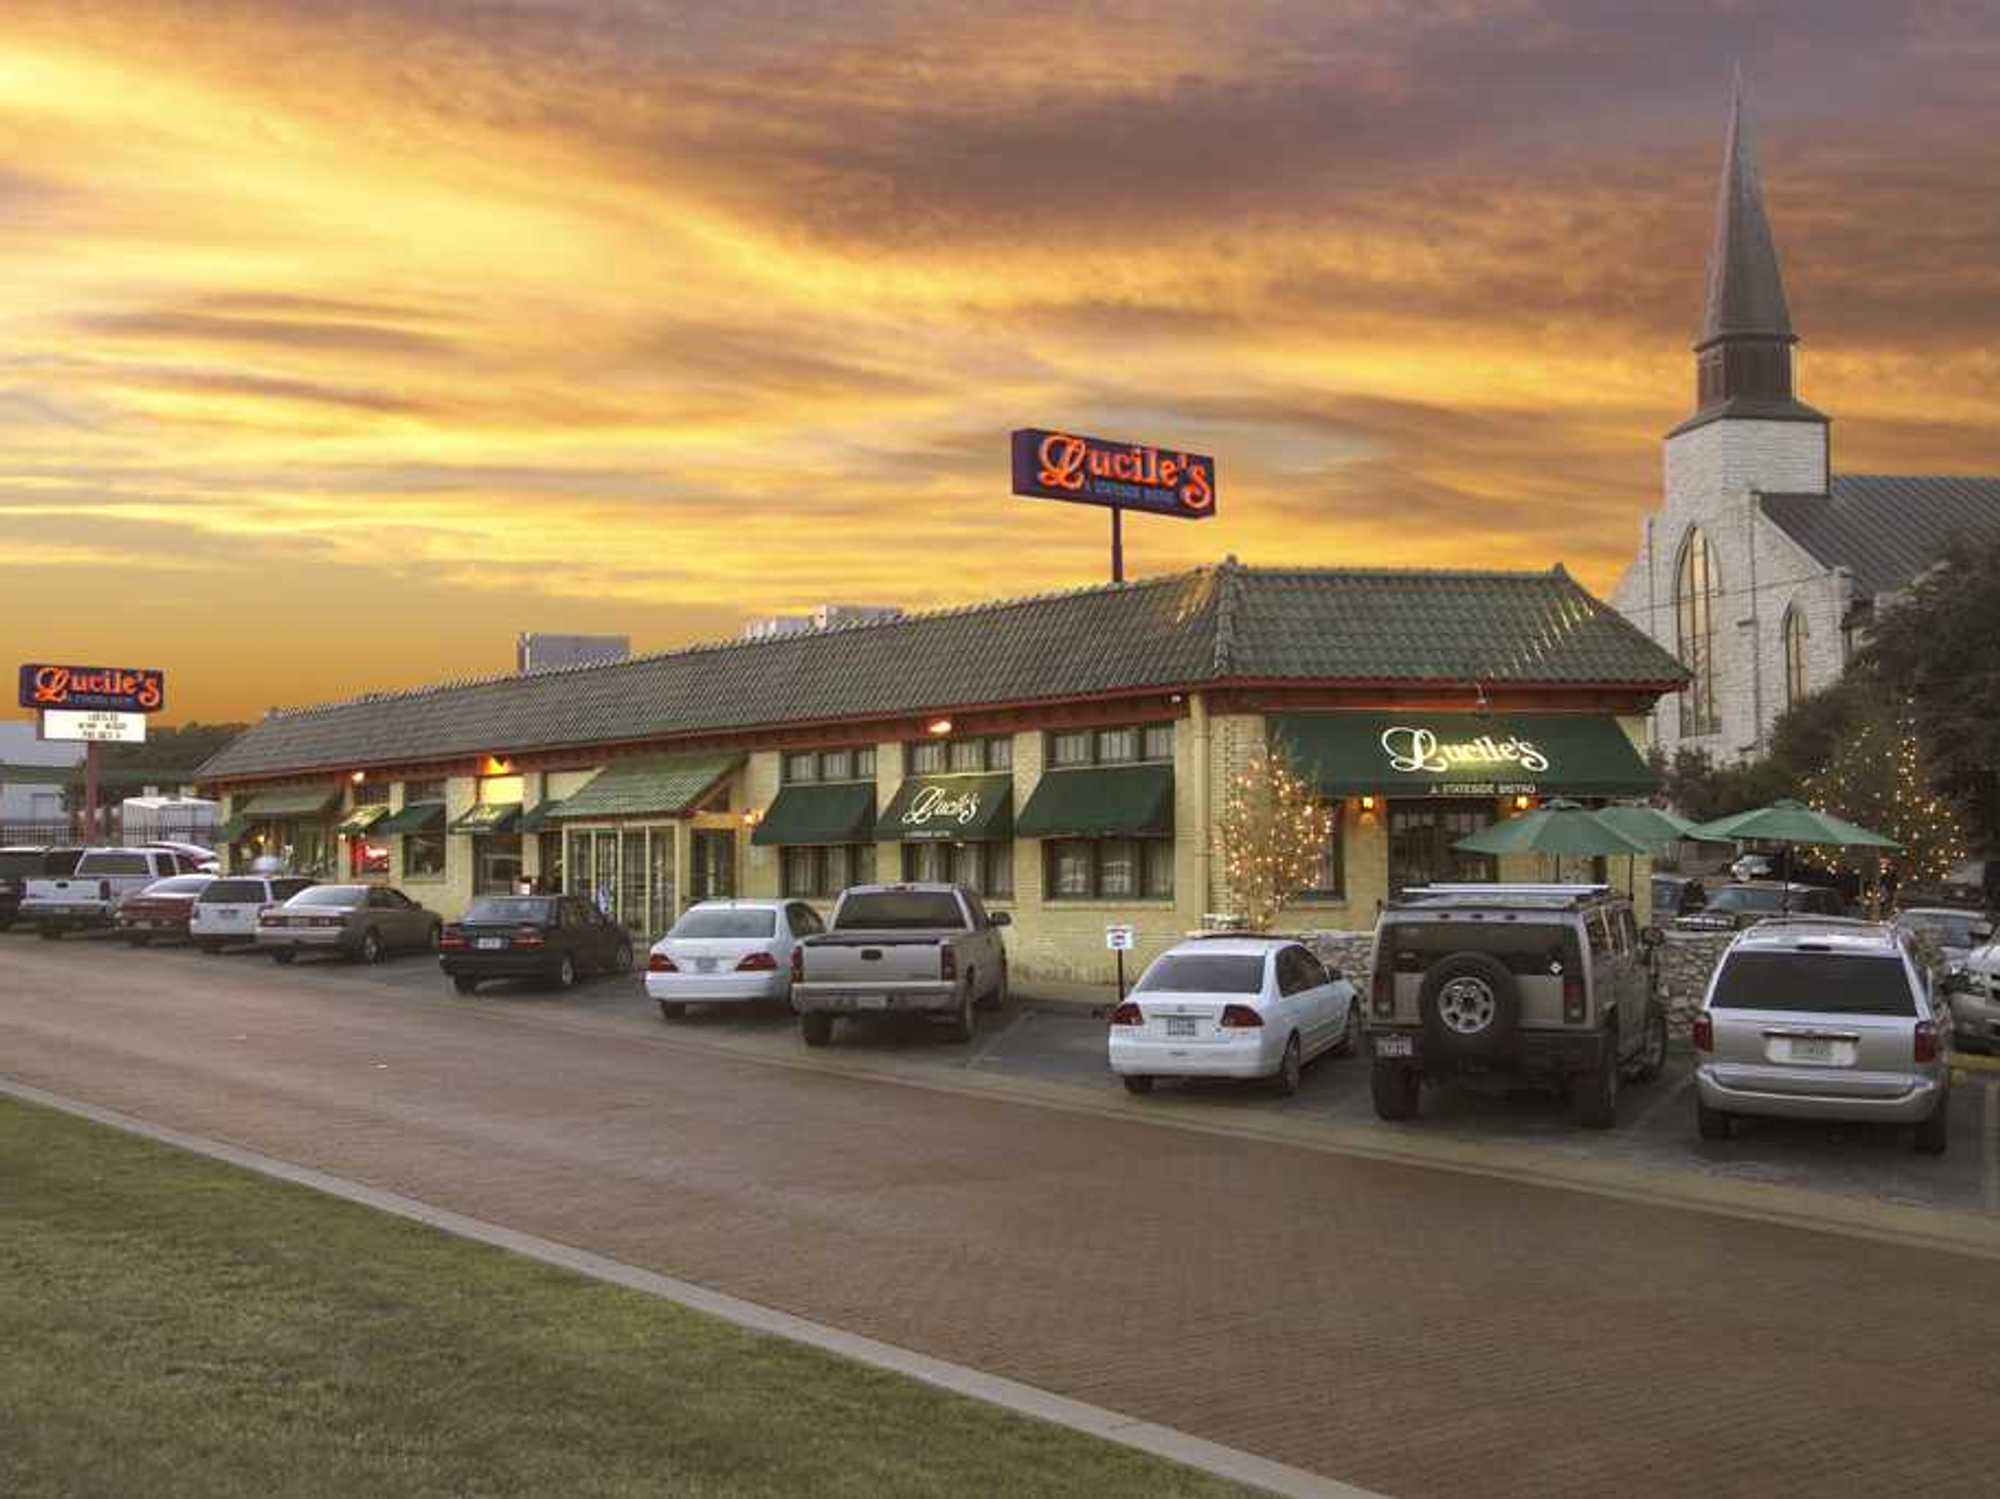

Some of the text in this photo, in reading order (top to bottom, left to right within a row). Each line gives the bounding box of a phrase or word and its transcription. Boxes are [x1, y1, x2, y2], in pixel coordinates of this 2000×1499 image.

[1038, 435, 1212, 508] Lucile's
[35, 667, 160, 706] Lucile's
[1381, 727, 1549, 772] Lucile's
